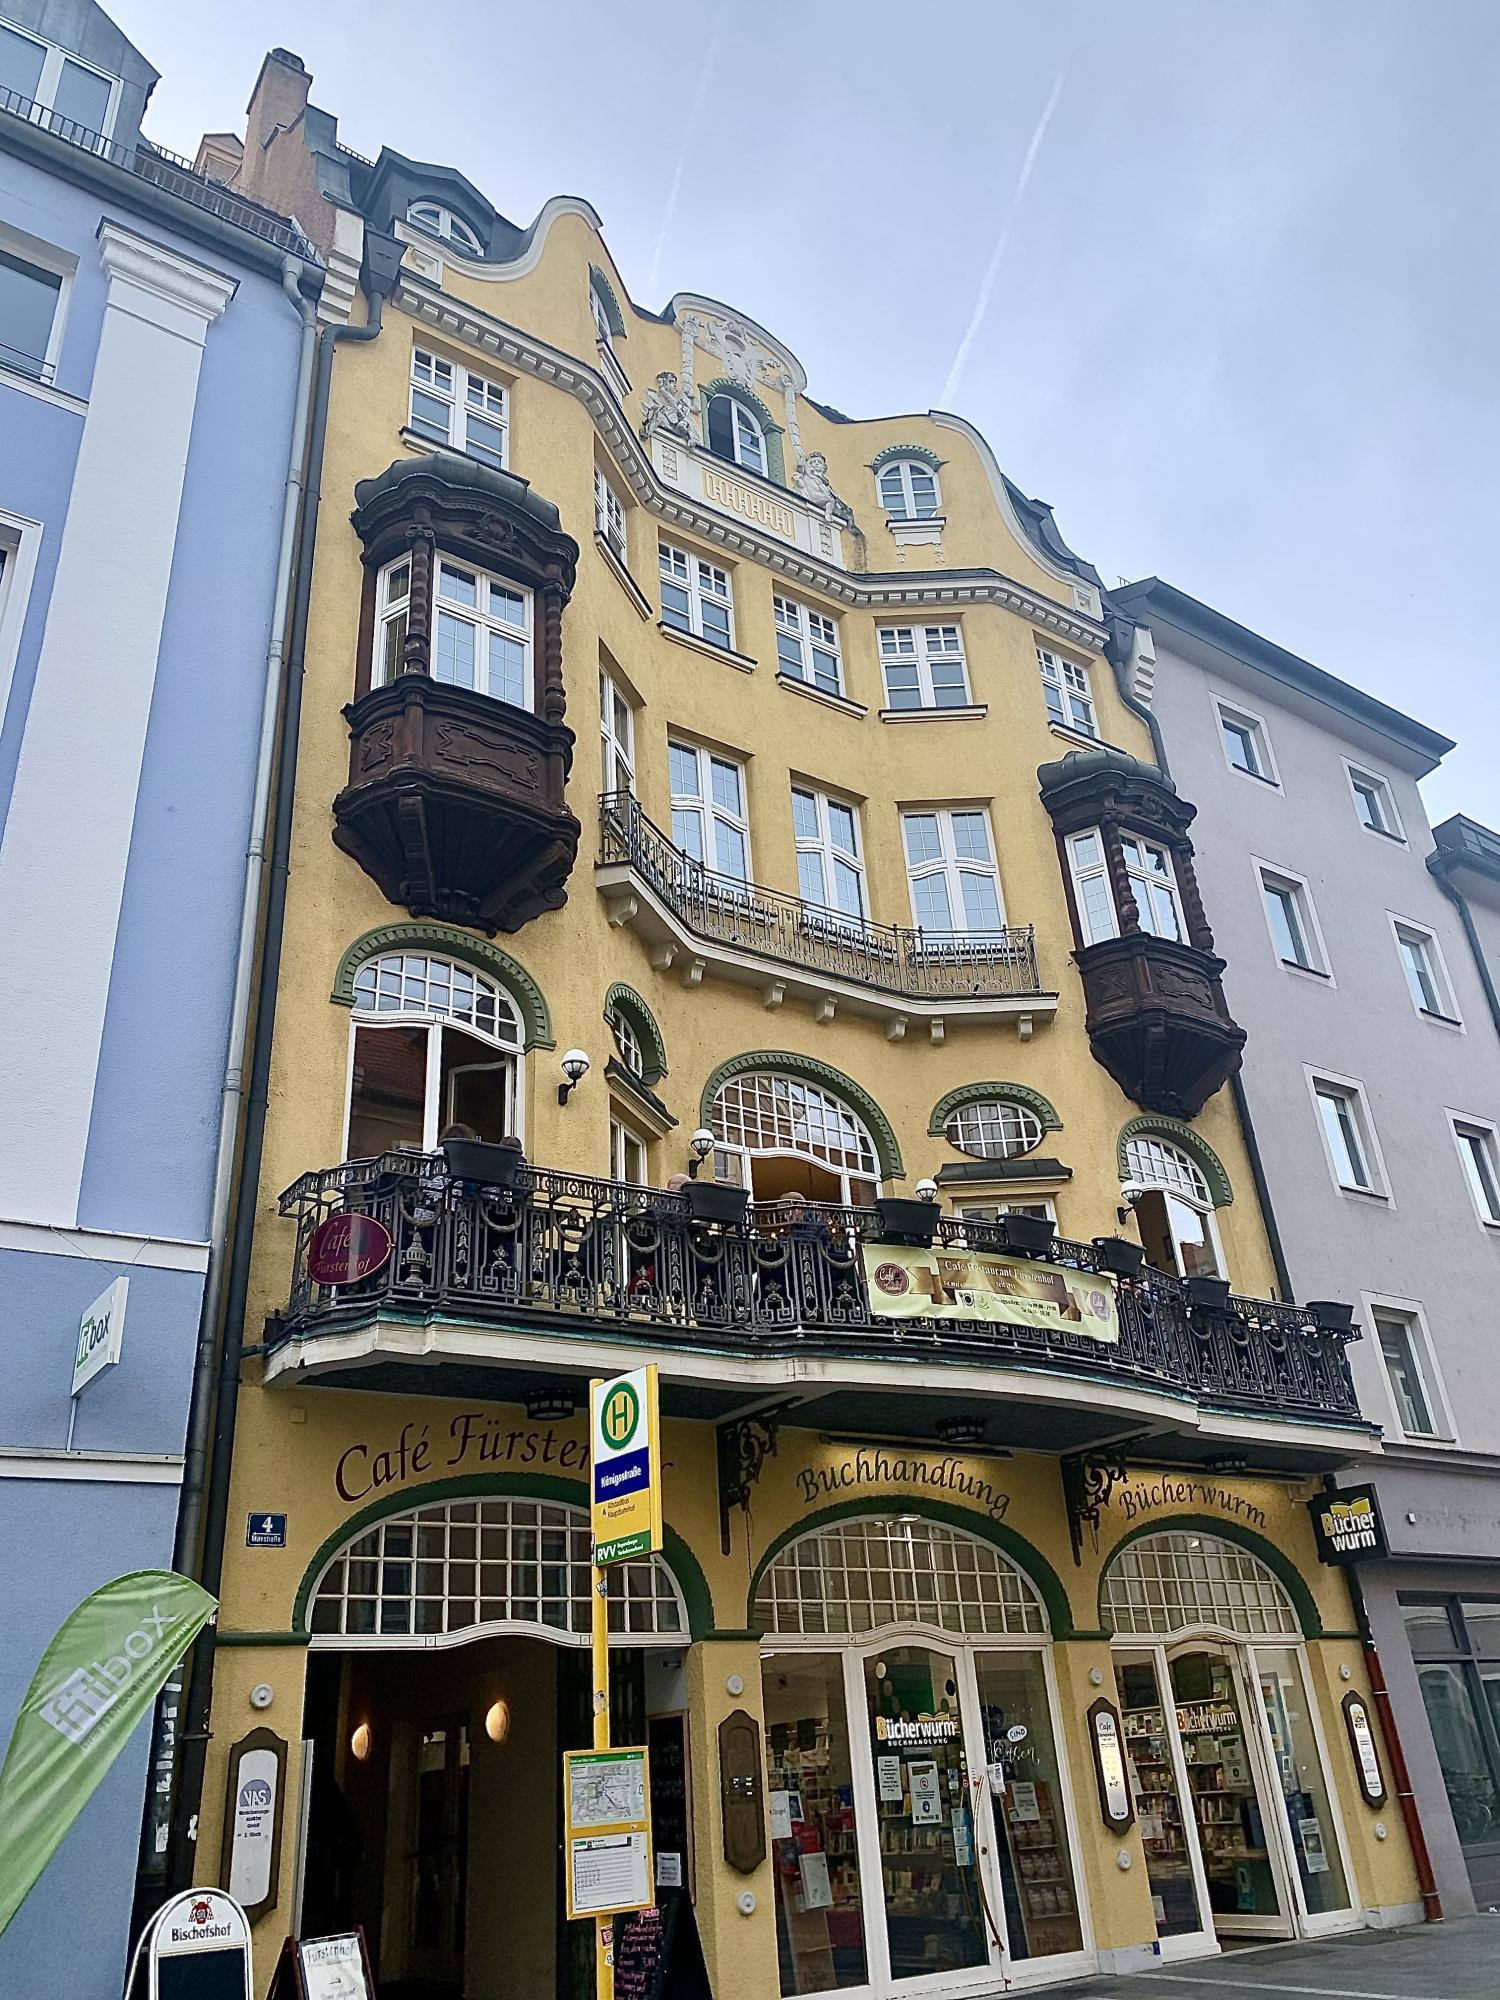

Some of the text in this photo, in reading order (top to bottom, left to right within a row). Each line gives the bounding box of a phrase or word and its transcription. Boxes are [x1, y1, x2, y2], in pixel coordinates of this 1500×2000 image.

[77, 1311, 111, 1364] fitbox
[335, 1423, 432, 1502] Café
[600, 1465, 642, 1488] Königsstraße
[796, 1447, 1011, 1521] Buchhandlung
[1118, 1473, 1267, 1529] Bücherwurm
[262, 1516, 273, 1533] 4
[1320, 1510, 1376, 1537] Bücher
[597, 1544, 616, 1562] RVV
[1331, 1530, 1377, 1552] wurm
[45, 1604, 177, 1739] fitbox
[875, 1716, 956, 1740] Bücherwurm
[887, 1738, 948, 1747] BUCHHANDLUNG
[171, 1921, 232, 1942] Bischofshof
